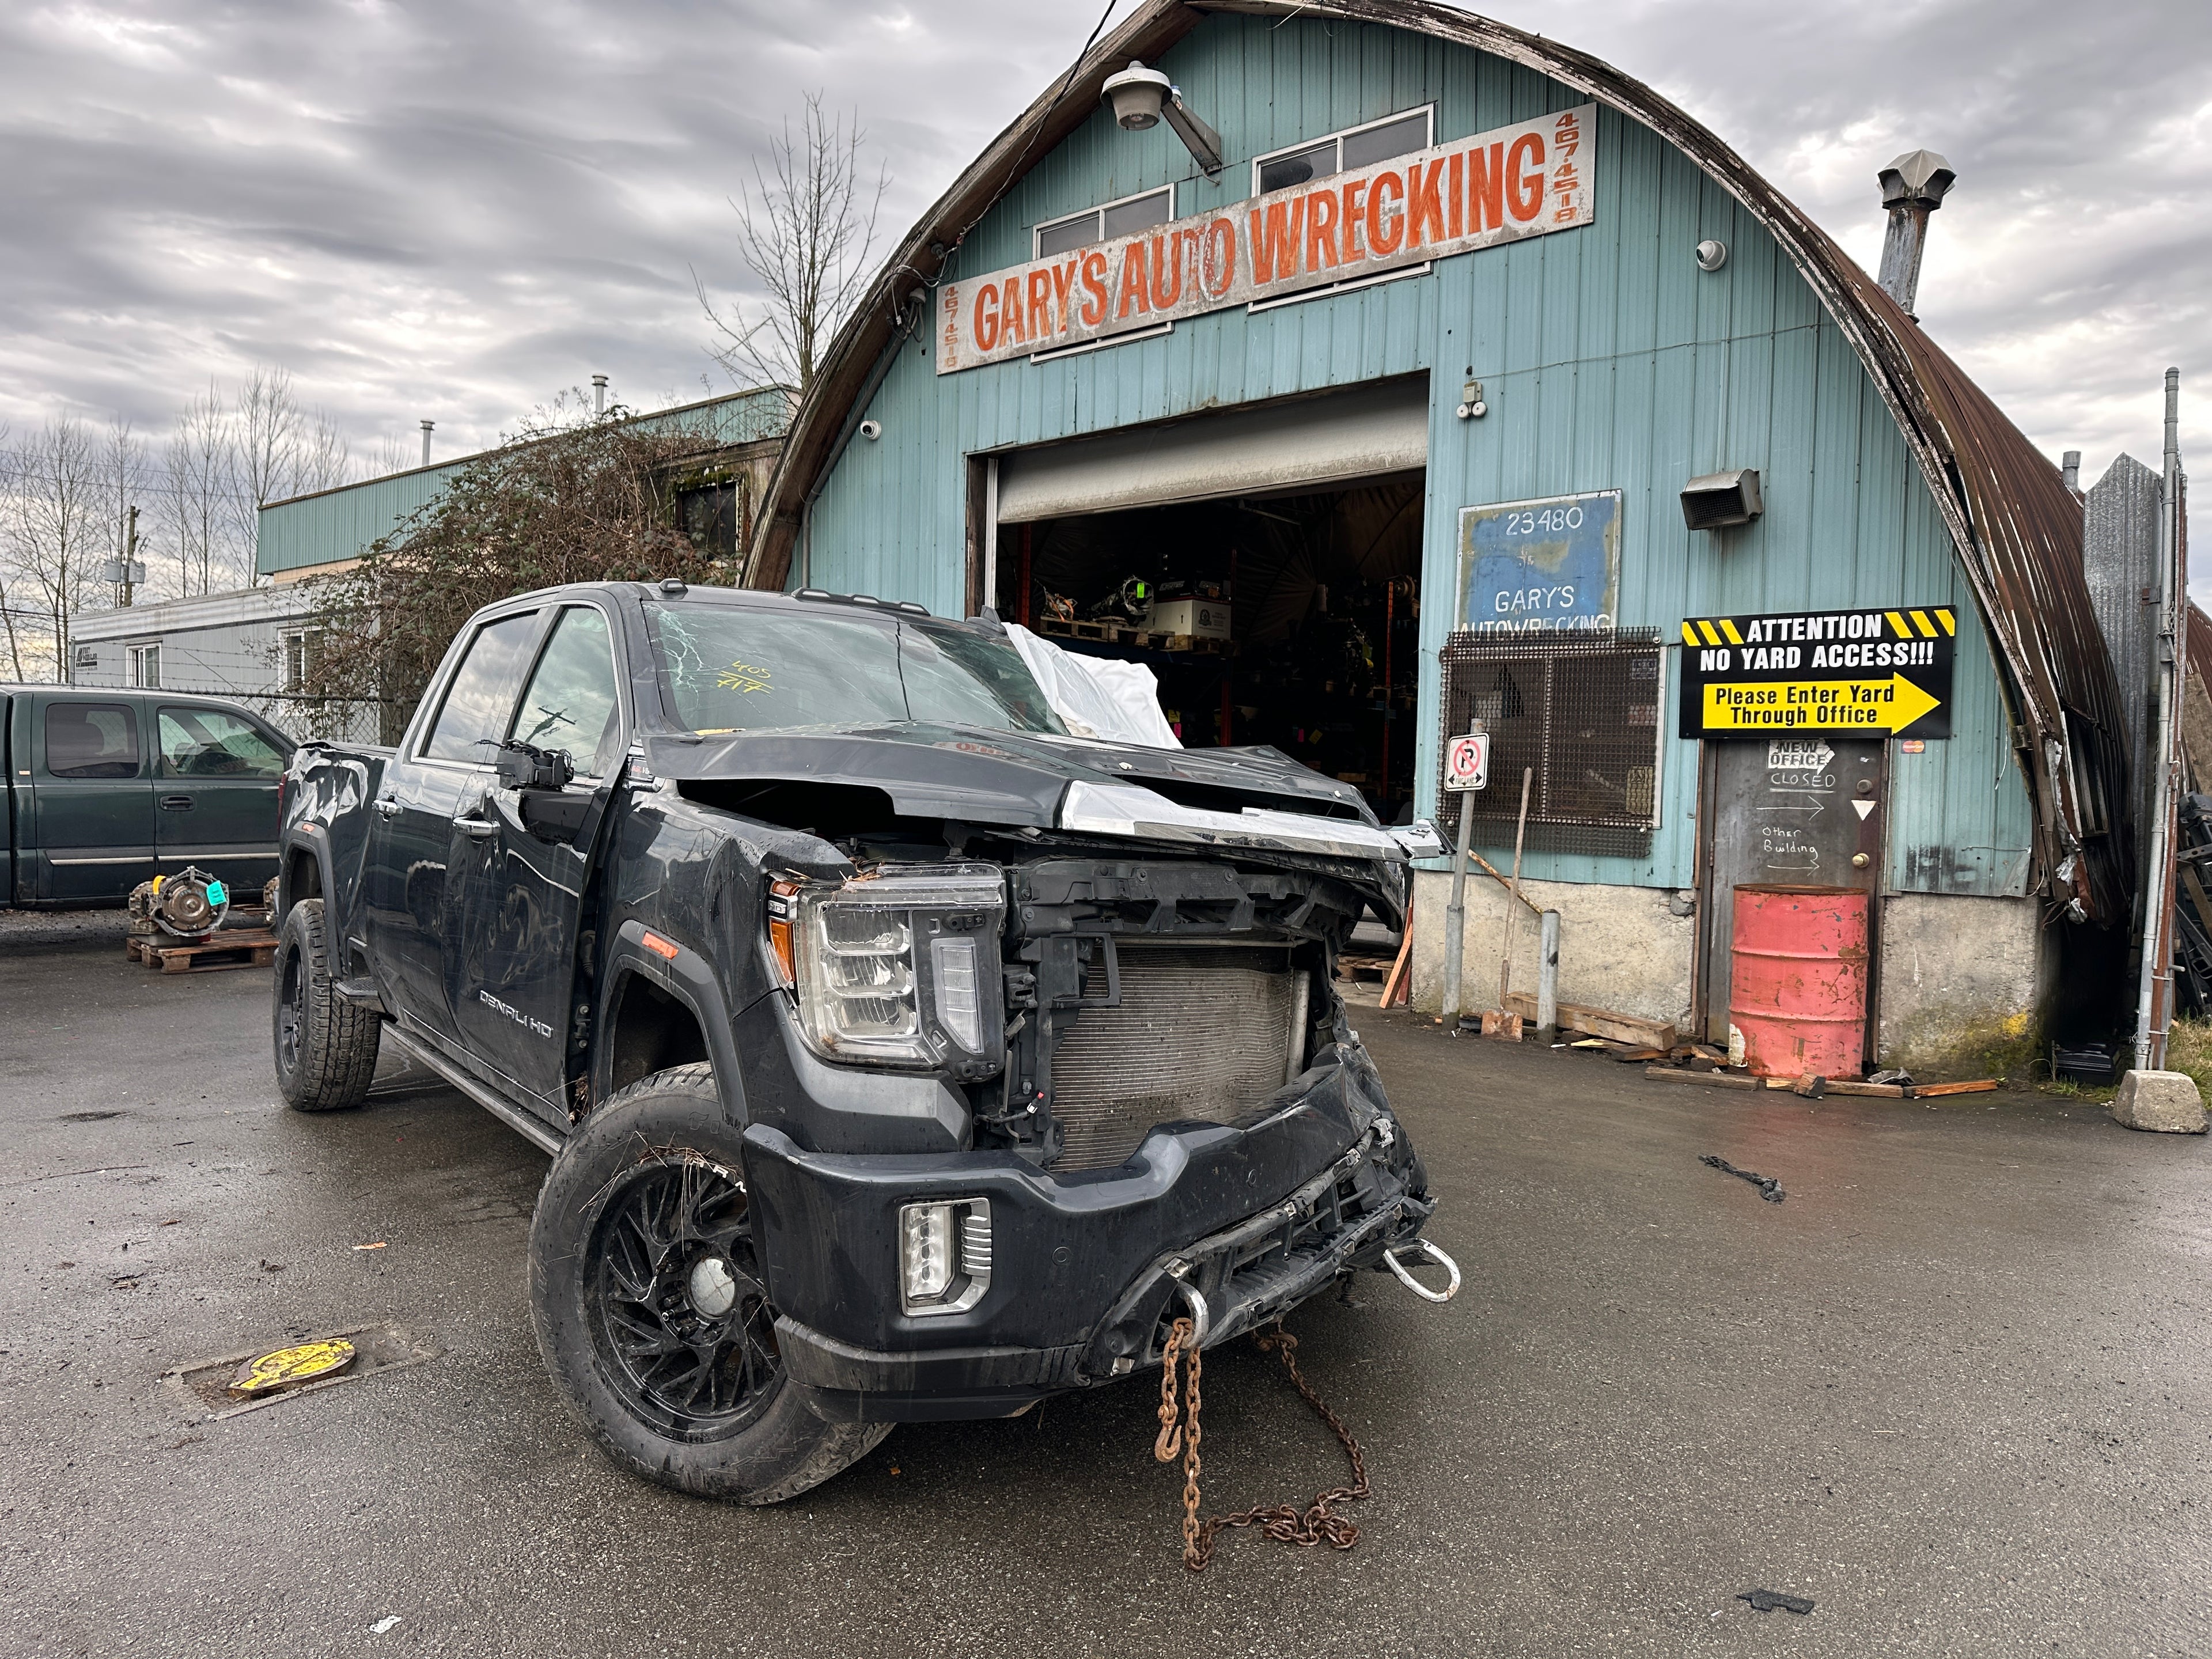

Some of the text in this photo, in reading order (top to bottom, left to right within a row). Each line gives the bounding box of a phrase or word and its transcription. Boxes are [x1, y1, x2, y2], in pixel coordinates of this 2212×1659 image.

[974, 132, 1546, 351] GARY'S AUTO WRECKING
[1505, 506, 1584, 536] 23480
[1495, 585, 1574, 612] GARY'S
[1746, 614, 1882, 642] ATTENTION
[1700, 641, 1934, 672] NO YARD ACCESS!!!
[1715, 684, 1895, 705] Please Enter Yard
[1730, 704, 1877, 726] Through Office
[1770, 752, 1827, 766] OFFICE
[1778, 741, 1817, 753] NEW
[1771, 772, 1836, 787] CLOSED
[1764, 839, 1819, 861] Building
[479, 990, 554, 1039] DENALI HD
